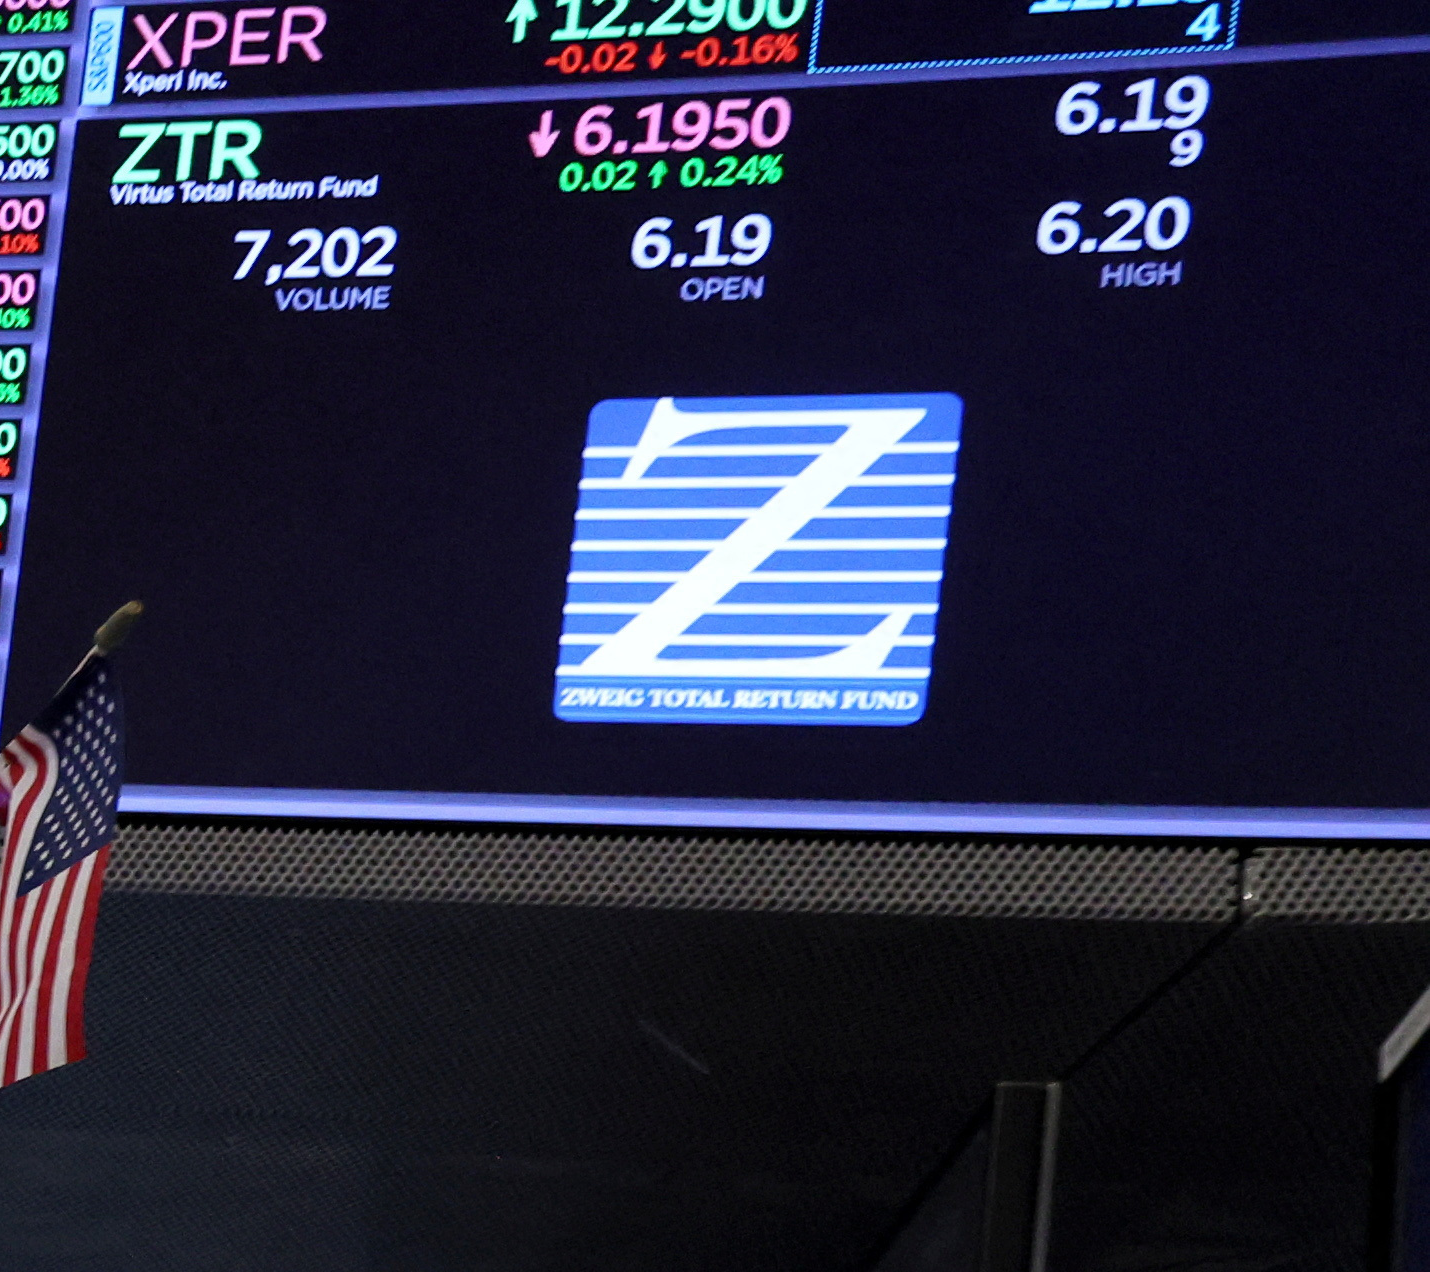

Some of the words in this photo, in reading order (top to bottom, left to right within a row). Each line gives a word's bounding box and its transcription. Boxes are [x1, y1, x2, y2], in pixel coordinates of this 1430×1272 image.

[126, 5, 327, 71] XPER
[1185, 2, 1223, 43] 4
[544, 41, 639, 74] -0.02
[680, 33, 799, 67] -0.16%
[1055, 74, 1212, 136] 6.19
[113, 120, 263, 184] ZTR
[574, 96, 792, 156] 6.1950
[1168, 128, 1206, 168] 9
[110, 183, 175, 206] Virtus
[179, 180, 234, 204] Total
[239, 178, 314, 203] Return
[318, 175, 379, 199] Fund
[559, 159, 638, 192] 0.02
[680, 153, 784, 188] 0.24%
[233, 225, 398, 286] 7,202
[630, 213, 773, 269] 6.19
[1036, 195, 1193, 255] 6.20
[275, 285, 392, 311] VOLUME
[680, 276, 765, 301] OPEN
[1100, 261, 1183, 288] HIGH
[561, 688, 644, 709] ZWEIG
[648, 688, 729, 710] TOTAL
[732, 689, 838, 711] RETURN
[841, 690, 918, 711] FUND
